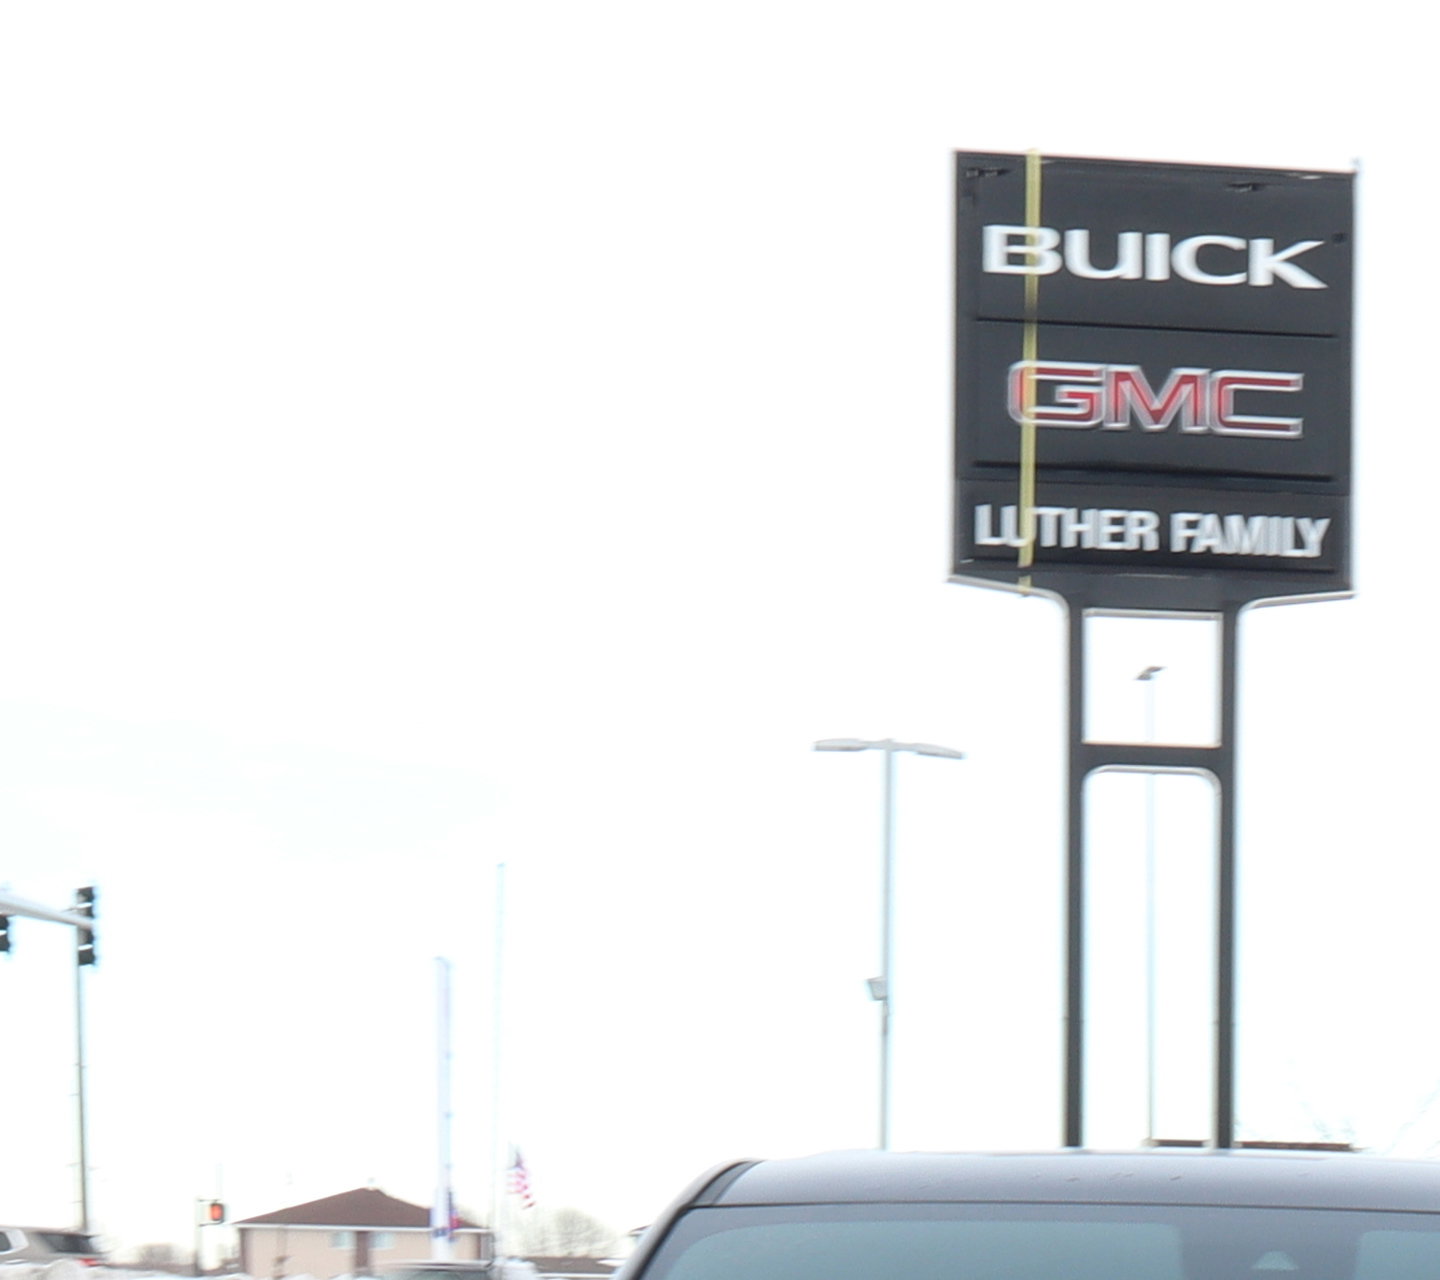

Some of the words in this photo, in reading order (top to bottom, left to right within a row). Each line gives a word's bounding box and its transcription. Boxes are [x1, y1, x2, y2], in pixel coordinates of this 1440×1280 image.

[982, 225, 1328, 289] BUICK
[1007, 360, 1304, 439] GMC
[974, 504, 1159, 552] LUTHER
[1170, 512, 1331, 558] FAMILY
